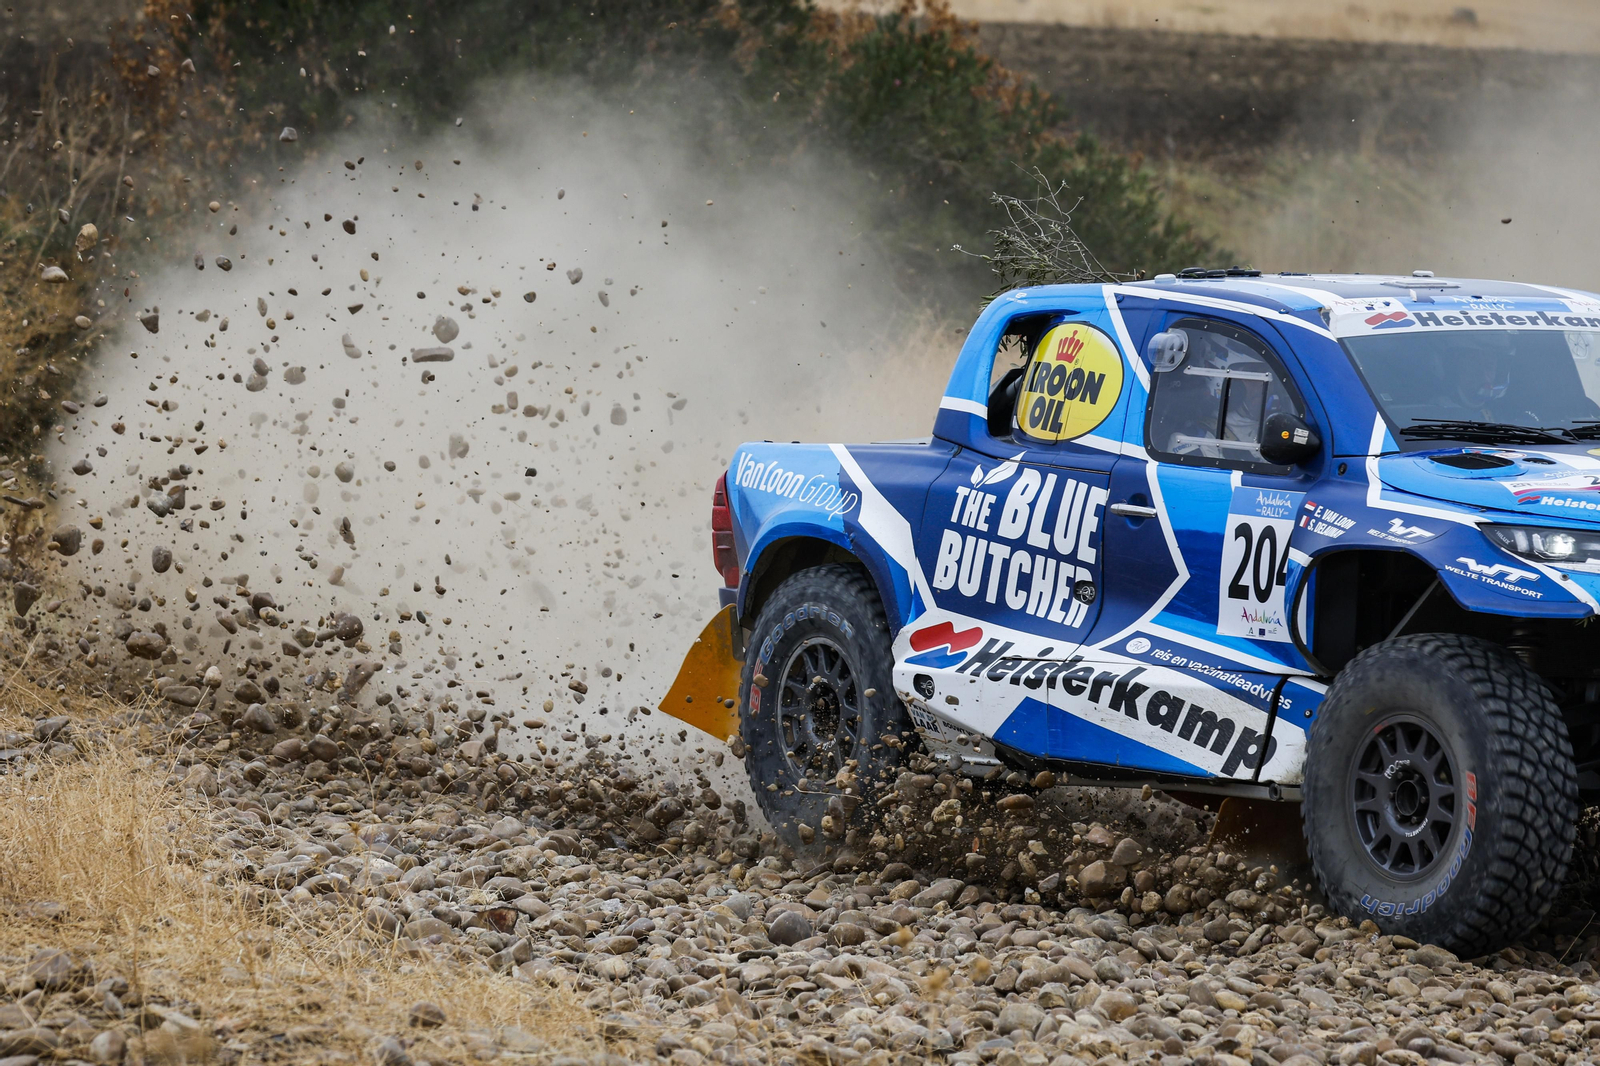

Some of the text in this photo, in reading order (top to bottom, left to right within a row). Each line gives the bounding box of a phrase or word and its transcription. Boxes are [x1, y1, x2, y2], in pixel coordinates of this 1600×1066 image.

[1470, 303, 1506, 311] RALLY
[1024, 361, 1106, 405] KROON
[1029, 395, 1065, 434] OIL
[799, 474, 858, 521] Group
[950, 467, 1111, 565] THE BLUE
[1260, 506, 1284, 517] RALLY
[1322, 508, 1340, 523] VAN
[1333, 514, 1357, 530] LOON
[932, 528, 1093, 629] BUTCHER
[1444, 564, 1543, 599] WELTE TRANSPORT
[1151, 648, 1293, 710] reis en vaccinatieadvies
[955, 637, 1278, 777] Heisterkamp
